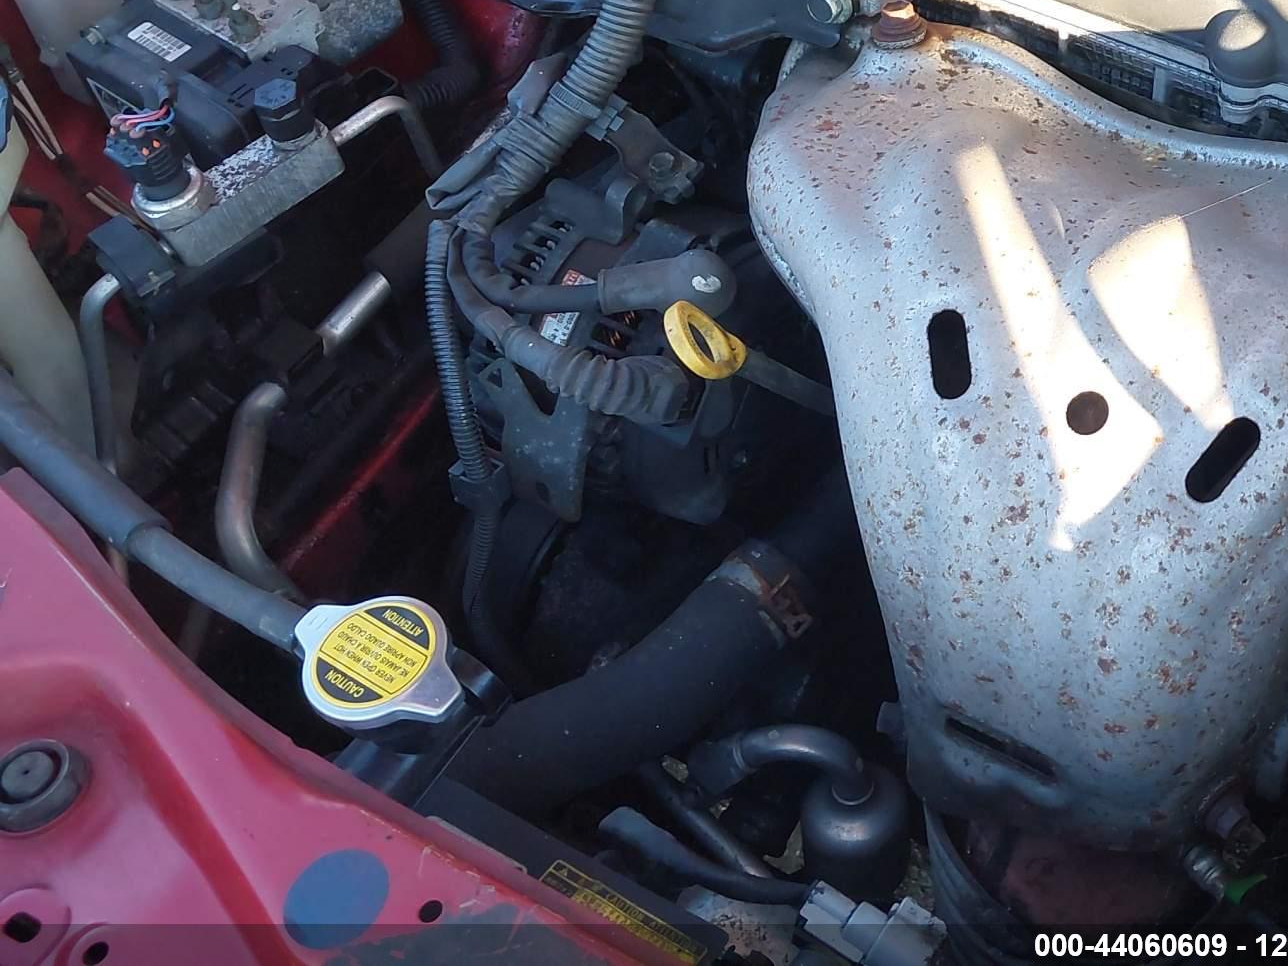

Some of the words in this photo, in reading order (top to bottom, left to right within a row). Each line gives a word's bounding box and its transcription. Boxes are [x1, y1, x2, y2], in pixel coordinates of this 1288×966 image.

[346, 622, 367, 638] CALDO
[382, 608, 425, 637] ATTENTION
[337, 631, 358, 646] CHAUD
[333, 643, 347, 656] HOT
[345, 648, 362, 665] WHEN
[360, 644, 382, 660] OUVRIR
[361, 658, 377, 674] OPEN
[380, 655, 402, 672] JAMAIS
[402, 655, 417, 668] NON
[374, 666, 395, 683] NEVER
[399, 667, 410, 678] NE
[325, 668, 365, 698] CAUTION
